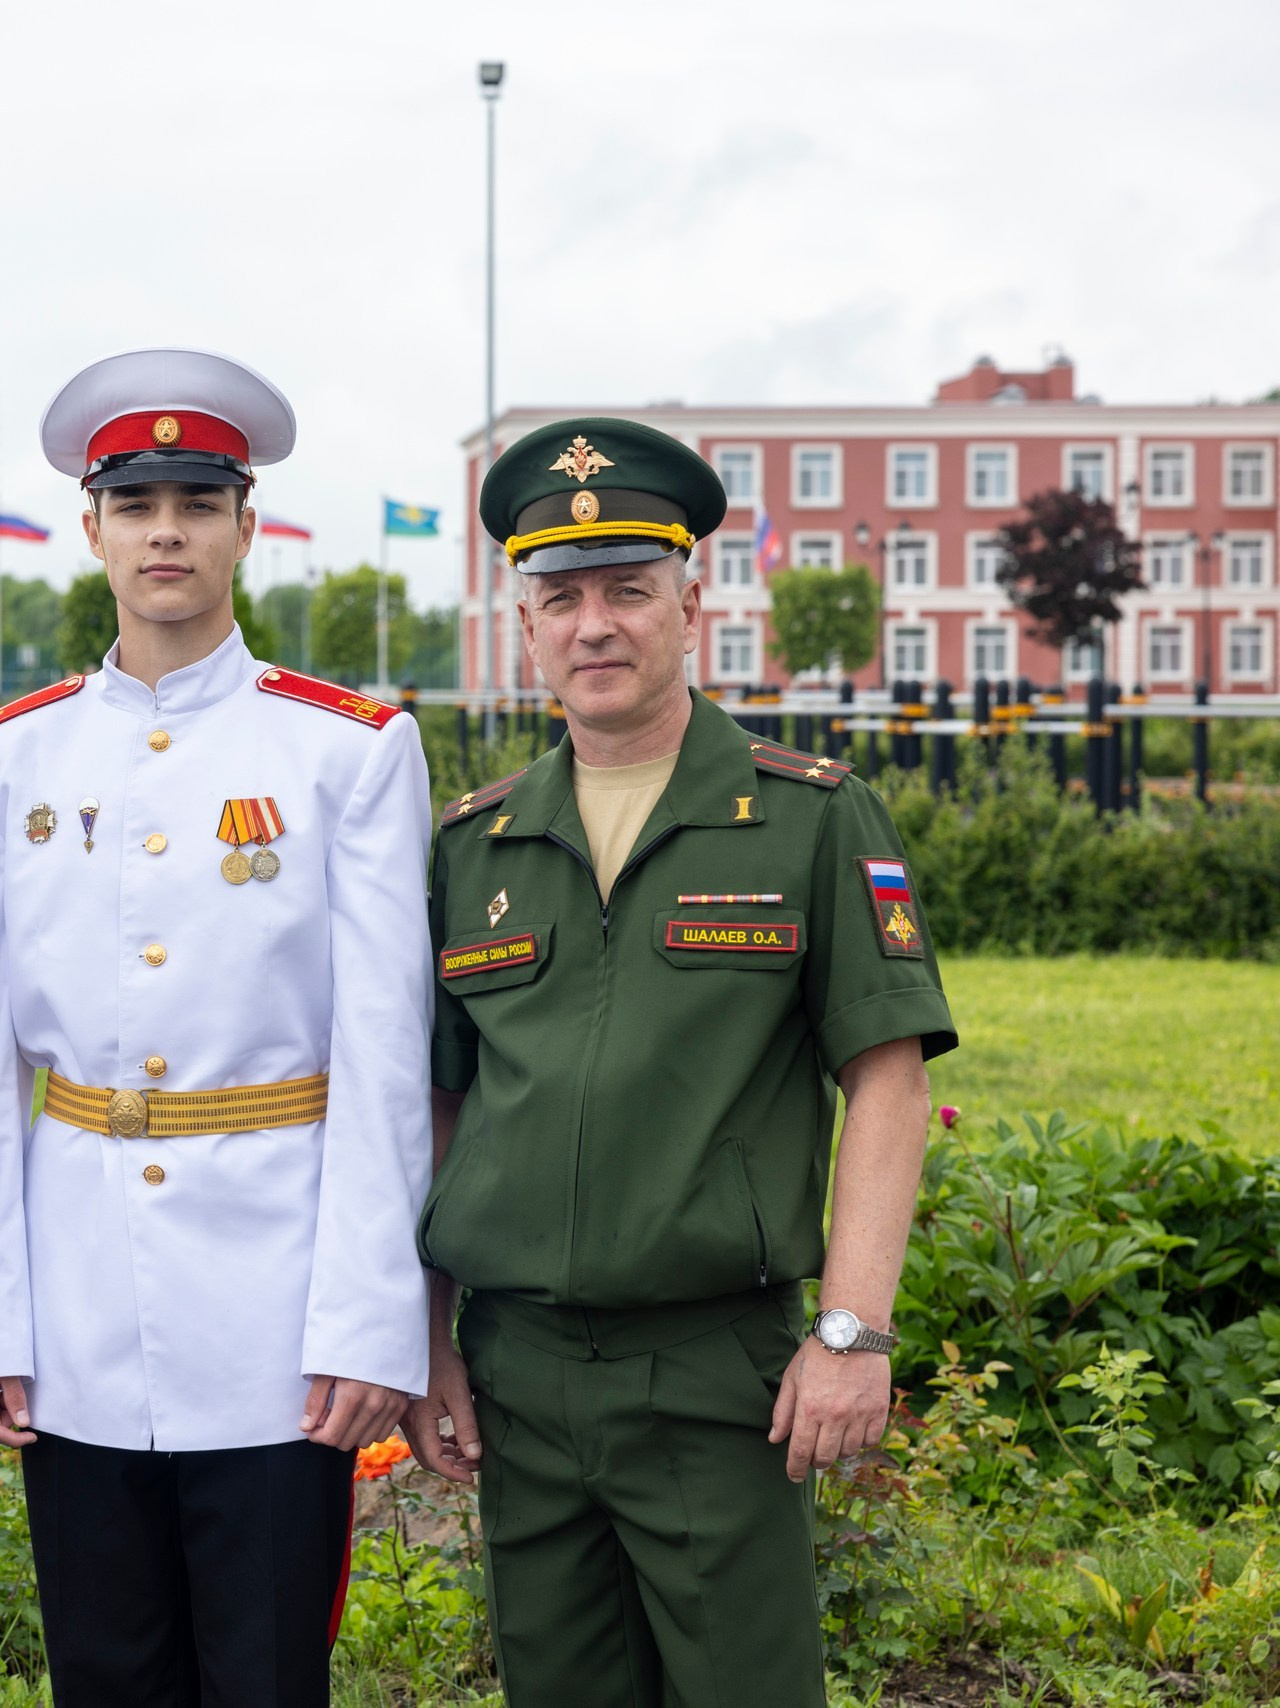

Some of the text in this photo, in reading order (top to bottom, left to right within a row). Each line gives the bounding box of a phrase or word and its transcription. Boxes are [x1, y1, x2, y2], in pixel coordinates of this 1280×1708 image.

[355, 700, 382, 718] СВУ
[683, 929, 782, 944] ШАЛАЕВ О.А.
[445, 940, 532, 970] ВООРУЖЕННЫЕ СИЛЫ РОССИИ
